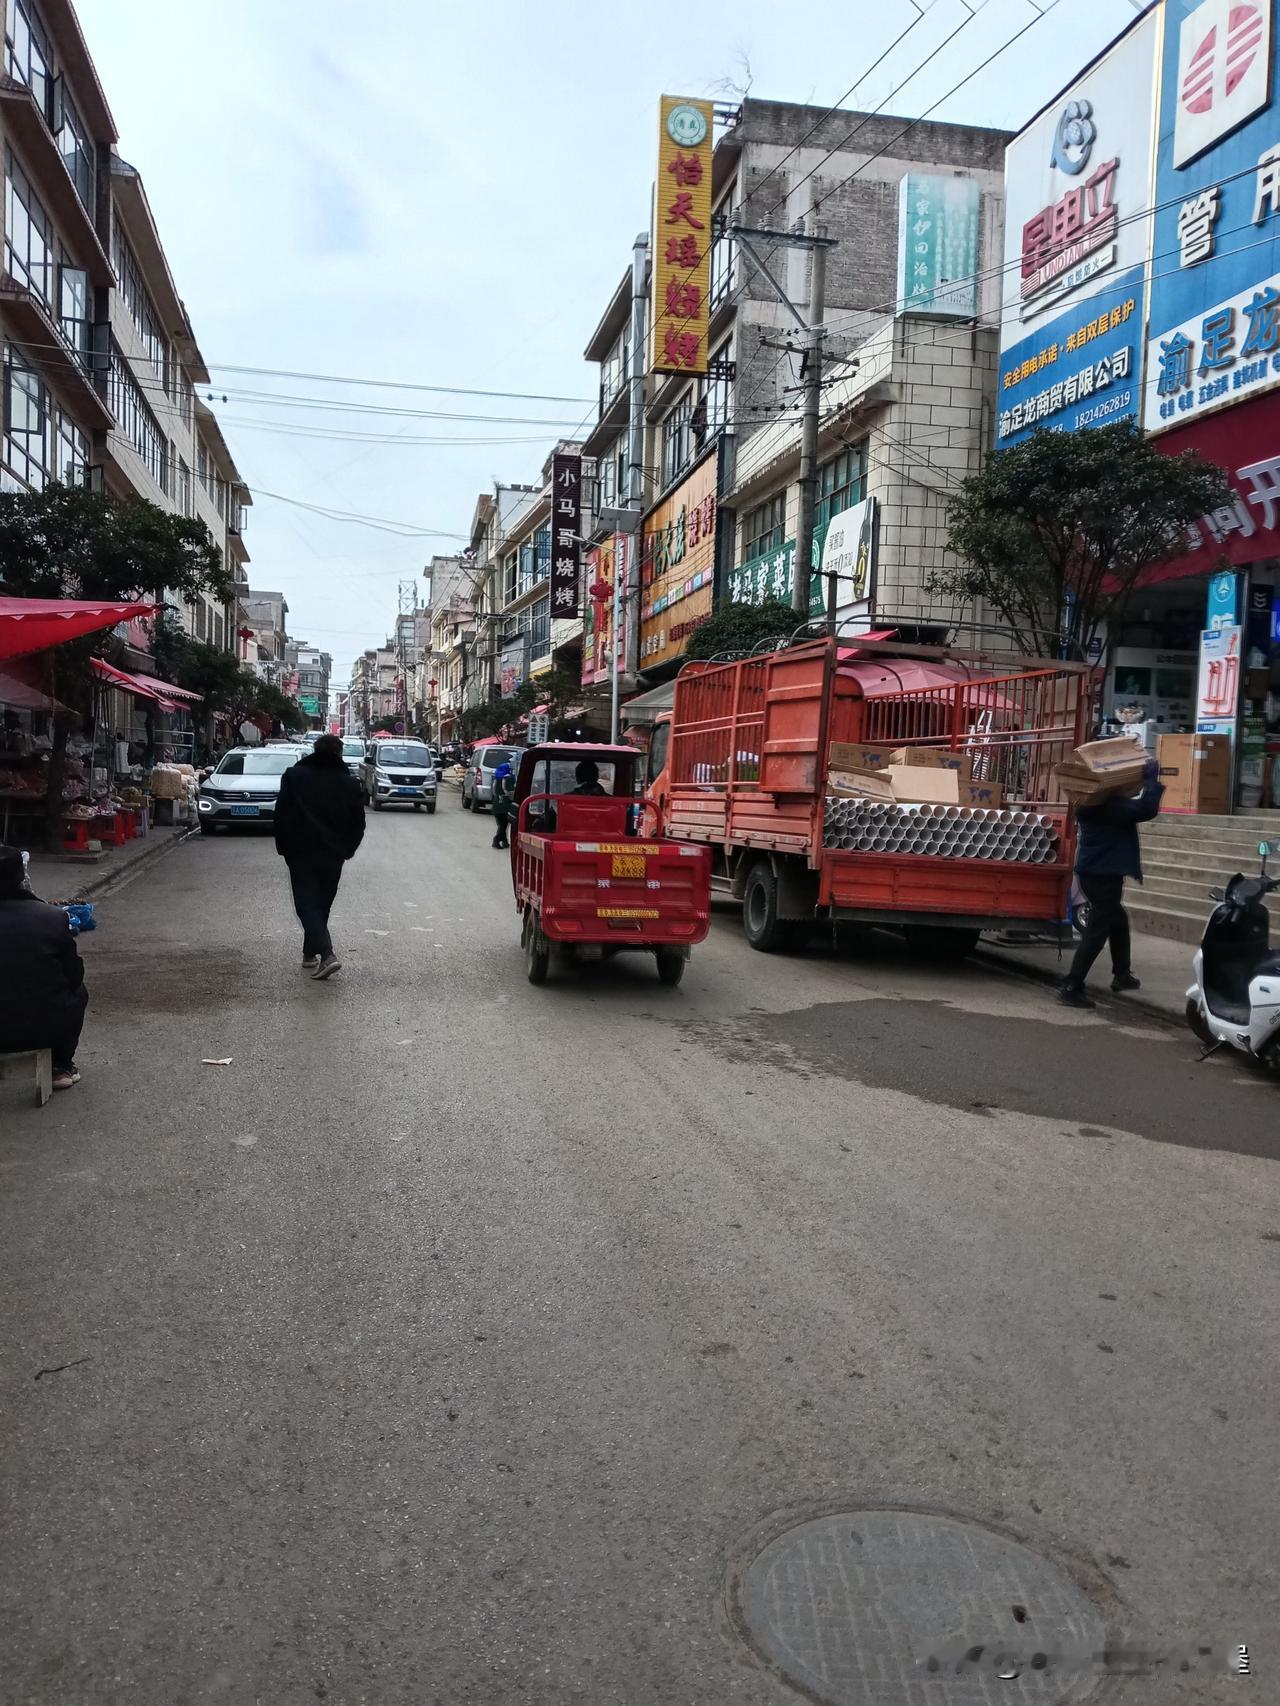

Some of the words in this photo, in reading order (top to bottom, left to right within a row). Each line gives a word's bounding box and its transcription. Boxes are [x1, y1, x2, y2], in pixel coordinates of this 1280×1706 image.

[998, 345, 1129, 438] 渝足龙商贸有限公司
[555, 467, 576, 607] 小马哥烧烤
